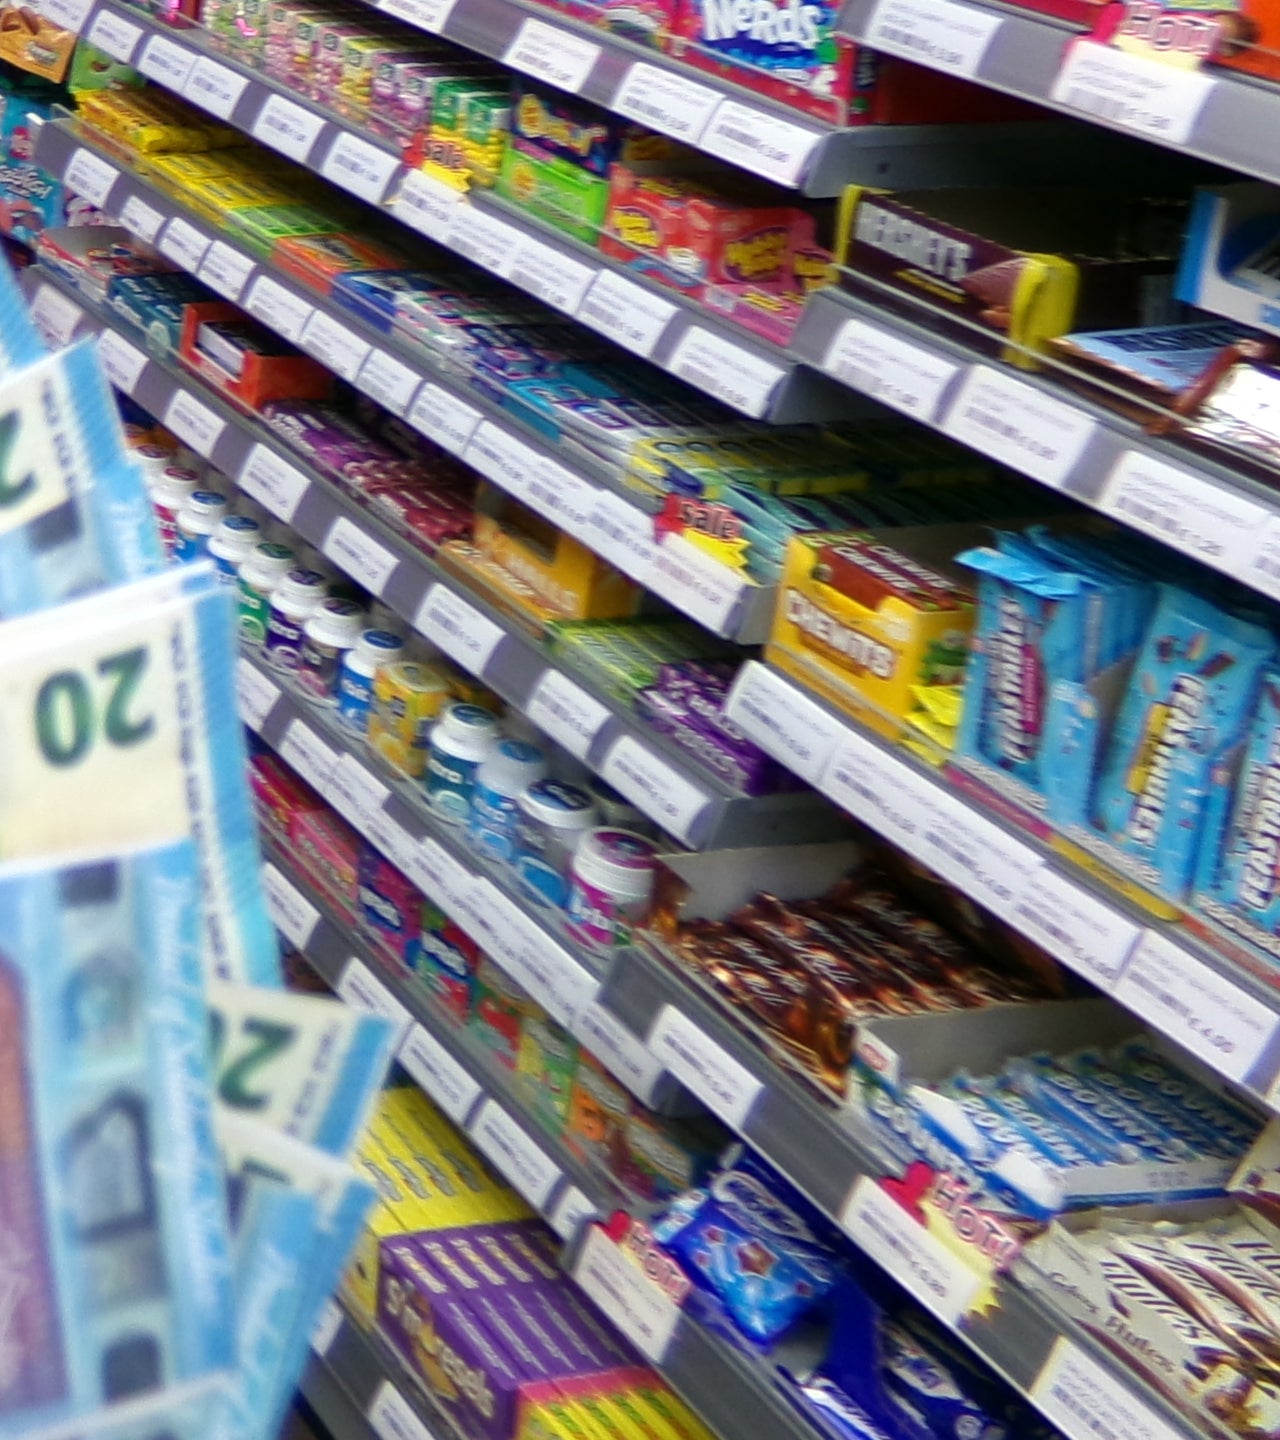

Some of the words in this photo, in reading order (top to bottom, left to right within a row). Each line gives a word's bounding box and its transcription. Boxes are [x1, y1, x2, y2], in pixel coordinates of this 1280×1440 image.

[678, 499, 741, 541] sale
[786, 588, 899, 681] CHEWITS
[33, 644, 158, 768] 20
[206, 1010, 298, 1115] 2
